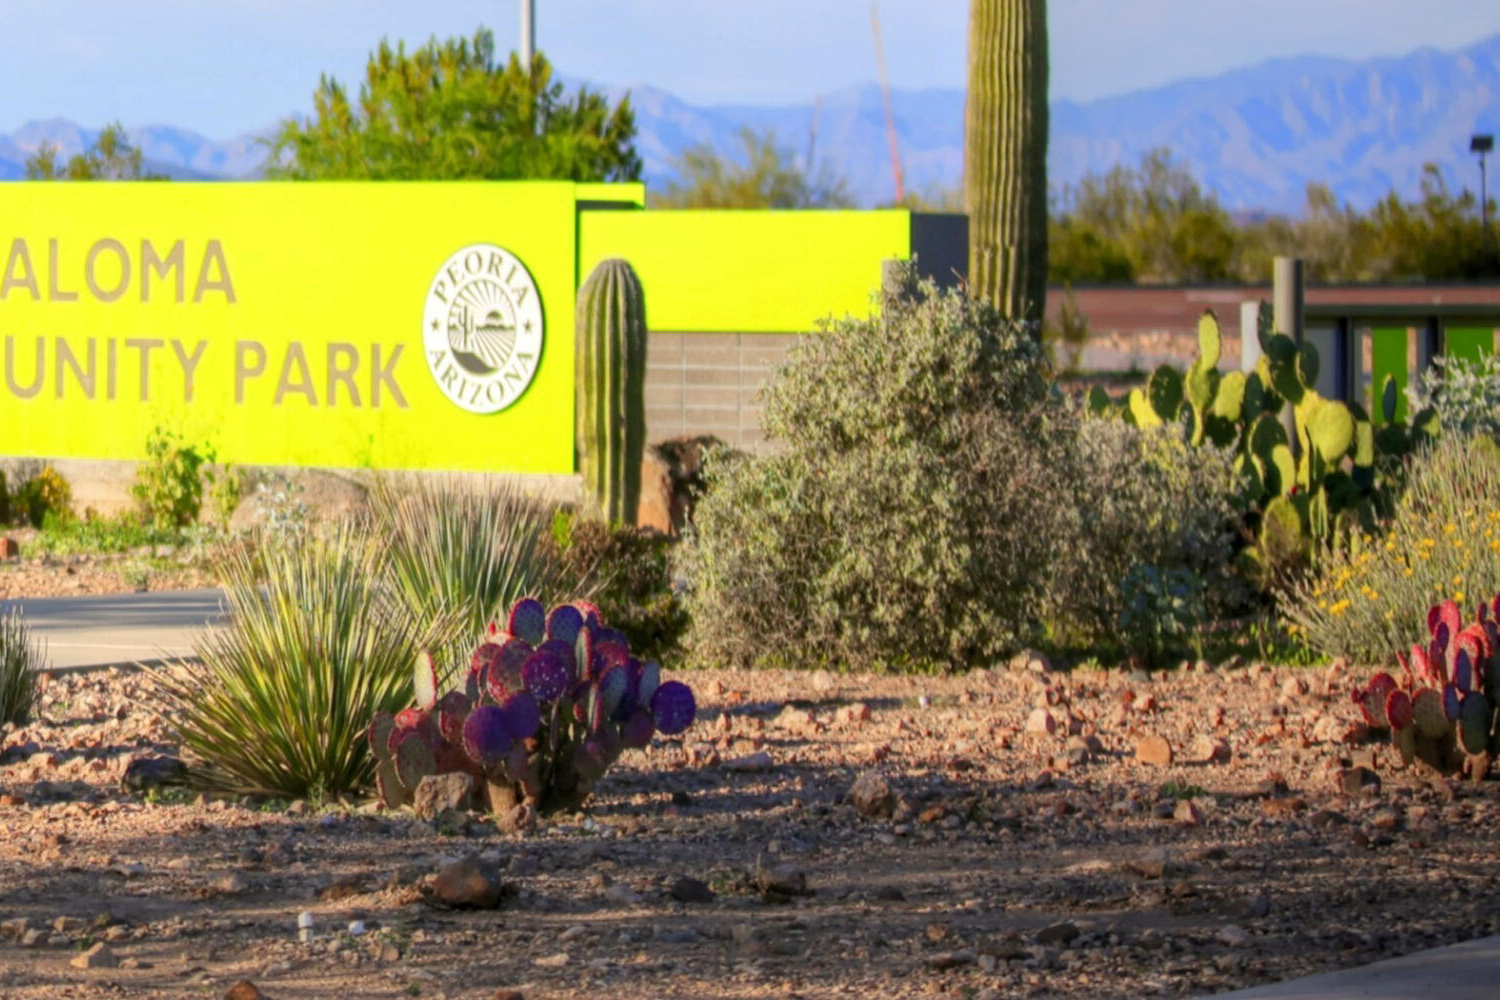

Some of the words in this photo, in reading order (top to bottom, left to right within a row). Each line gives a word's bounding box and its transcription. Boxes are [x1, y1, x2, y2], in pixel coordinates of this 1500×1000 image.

[433, 250, 529, 307] PEORIA
[234, 340, 409, 409] PARK
[429, 350, 534, 408] ARIZONA
